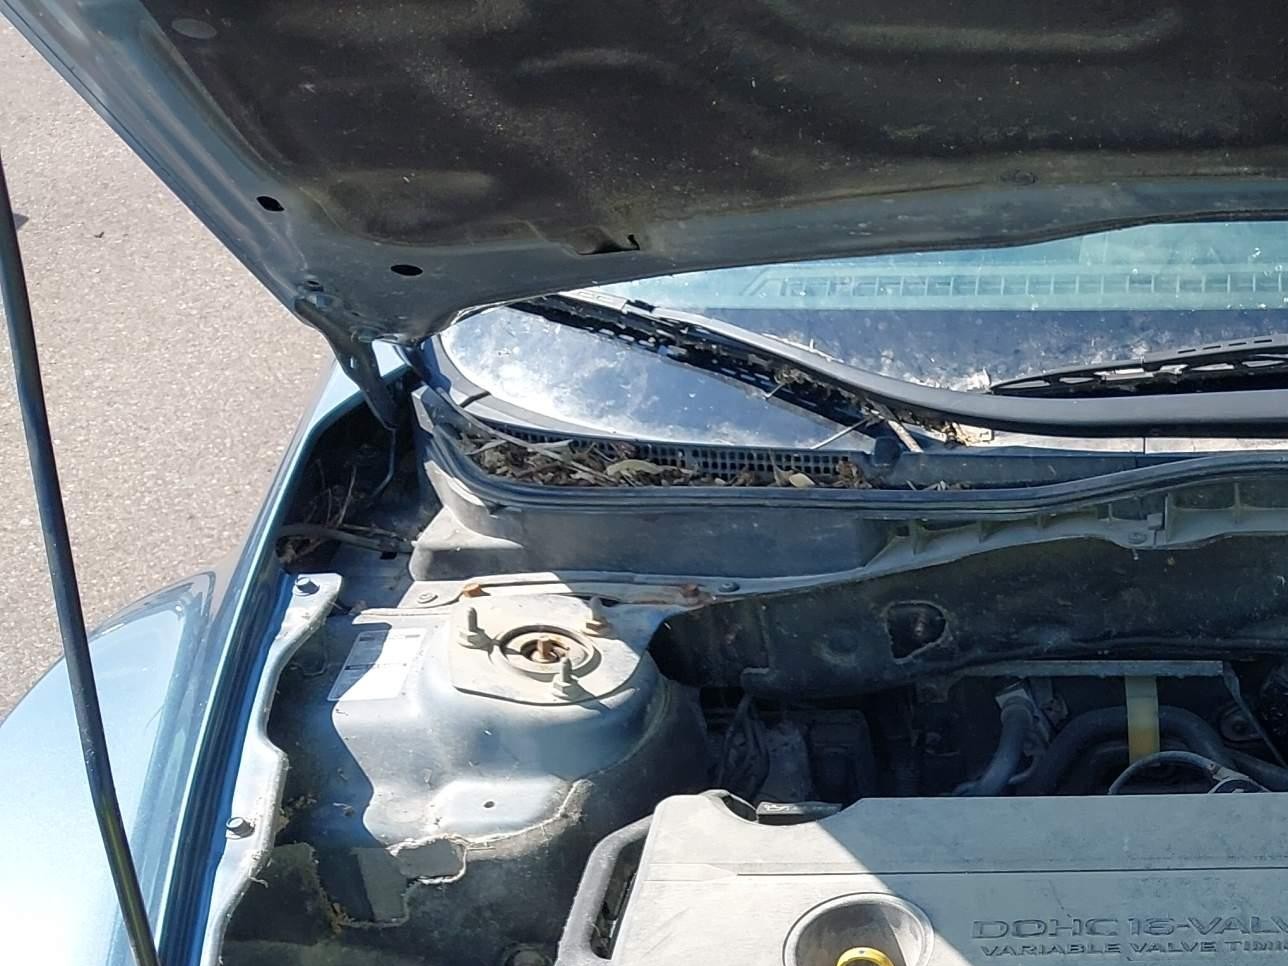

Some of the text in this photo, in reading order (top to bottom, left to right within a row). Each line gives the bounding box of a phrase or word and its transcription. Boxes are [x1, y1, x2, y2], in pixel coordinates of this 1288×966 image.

[972, 918, 1120, 939] DOHC
[980, 943, 1121, 957] VARIABLE
[1129, 941, 1217, 954] VALVE
